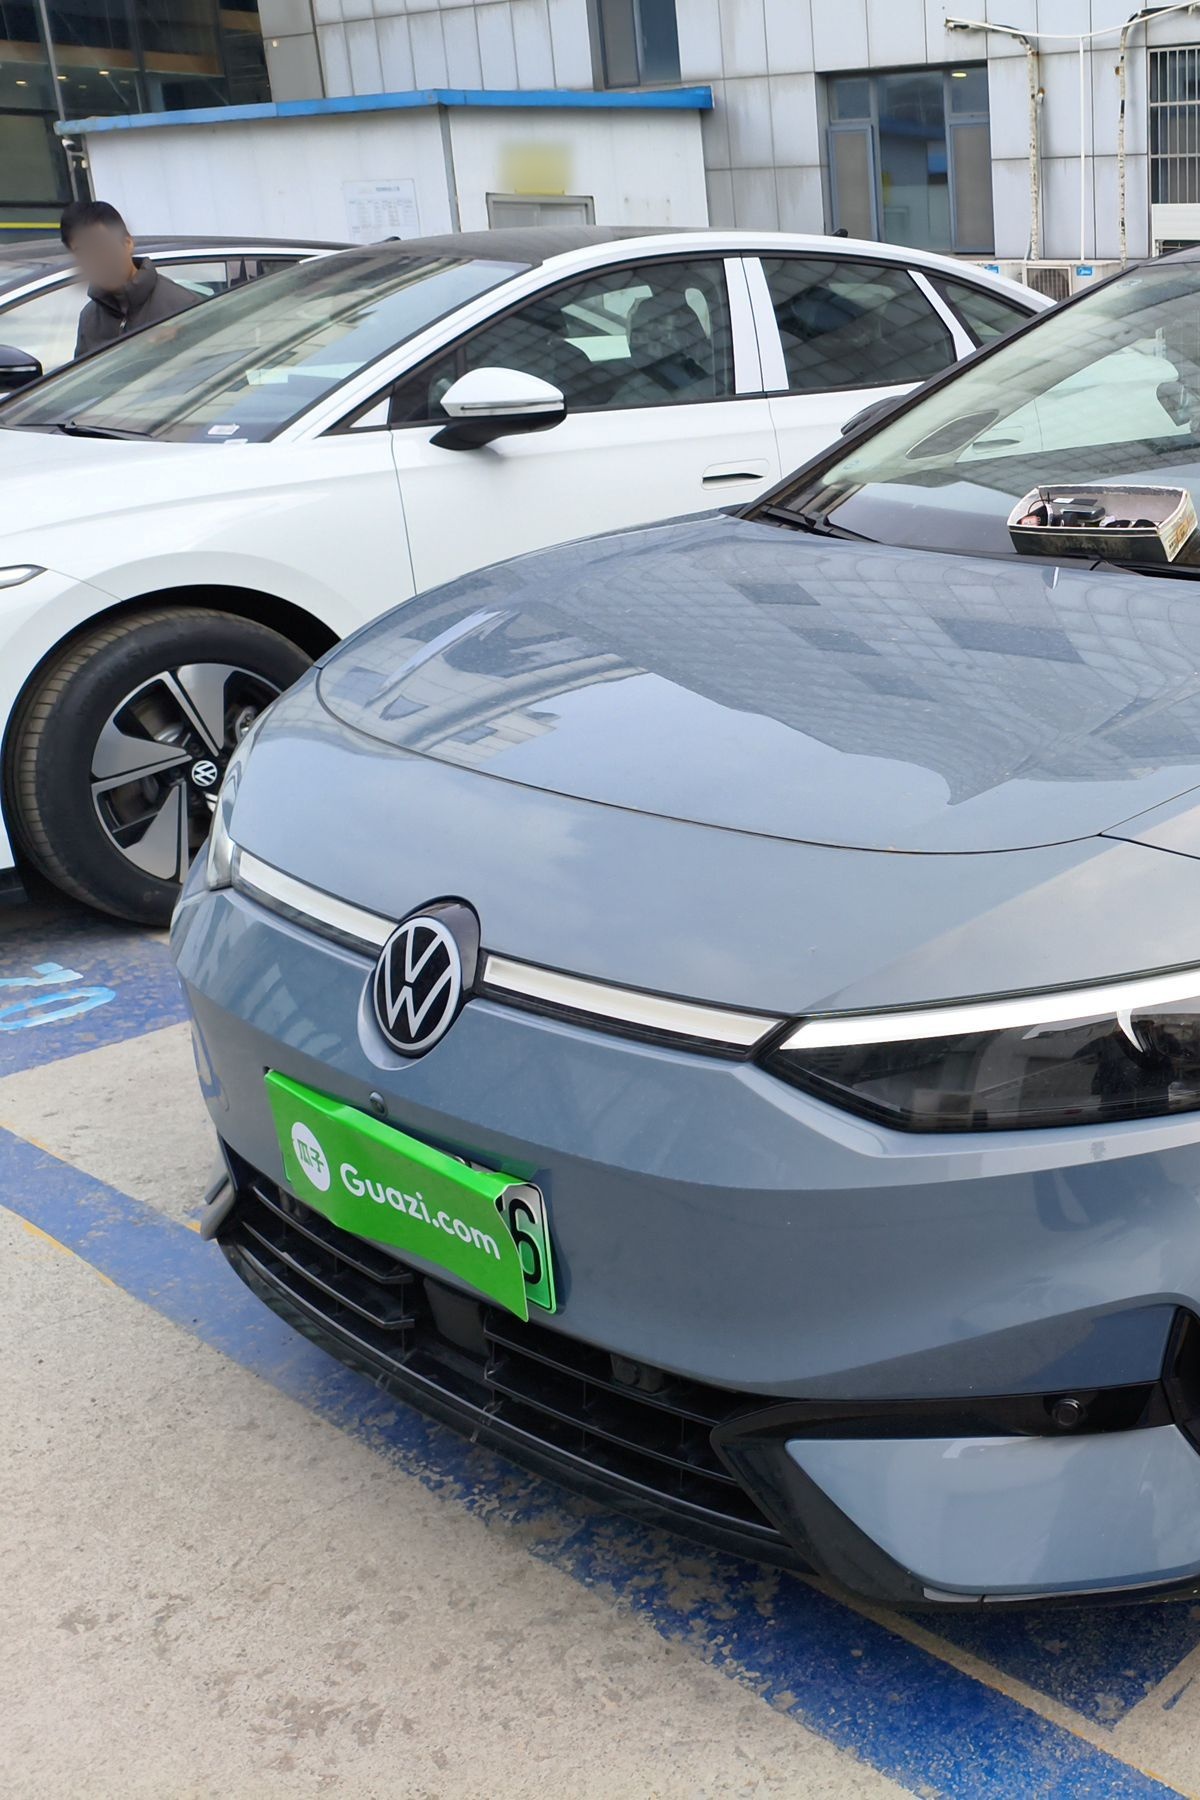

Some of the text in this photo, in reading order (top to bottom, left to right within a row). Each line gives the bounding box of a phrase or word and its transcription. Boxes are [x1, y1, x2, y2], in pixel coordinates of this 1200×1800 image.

[374, 917, 461, 1050] VW
[296, 1138, 325, 1174] 瓜子
[340, 1162, 501, 1260] Guazi.com
